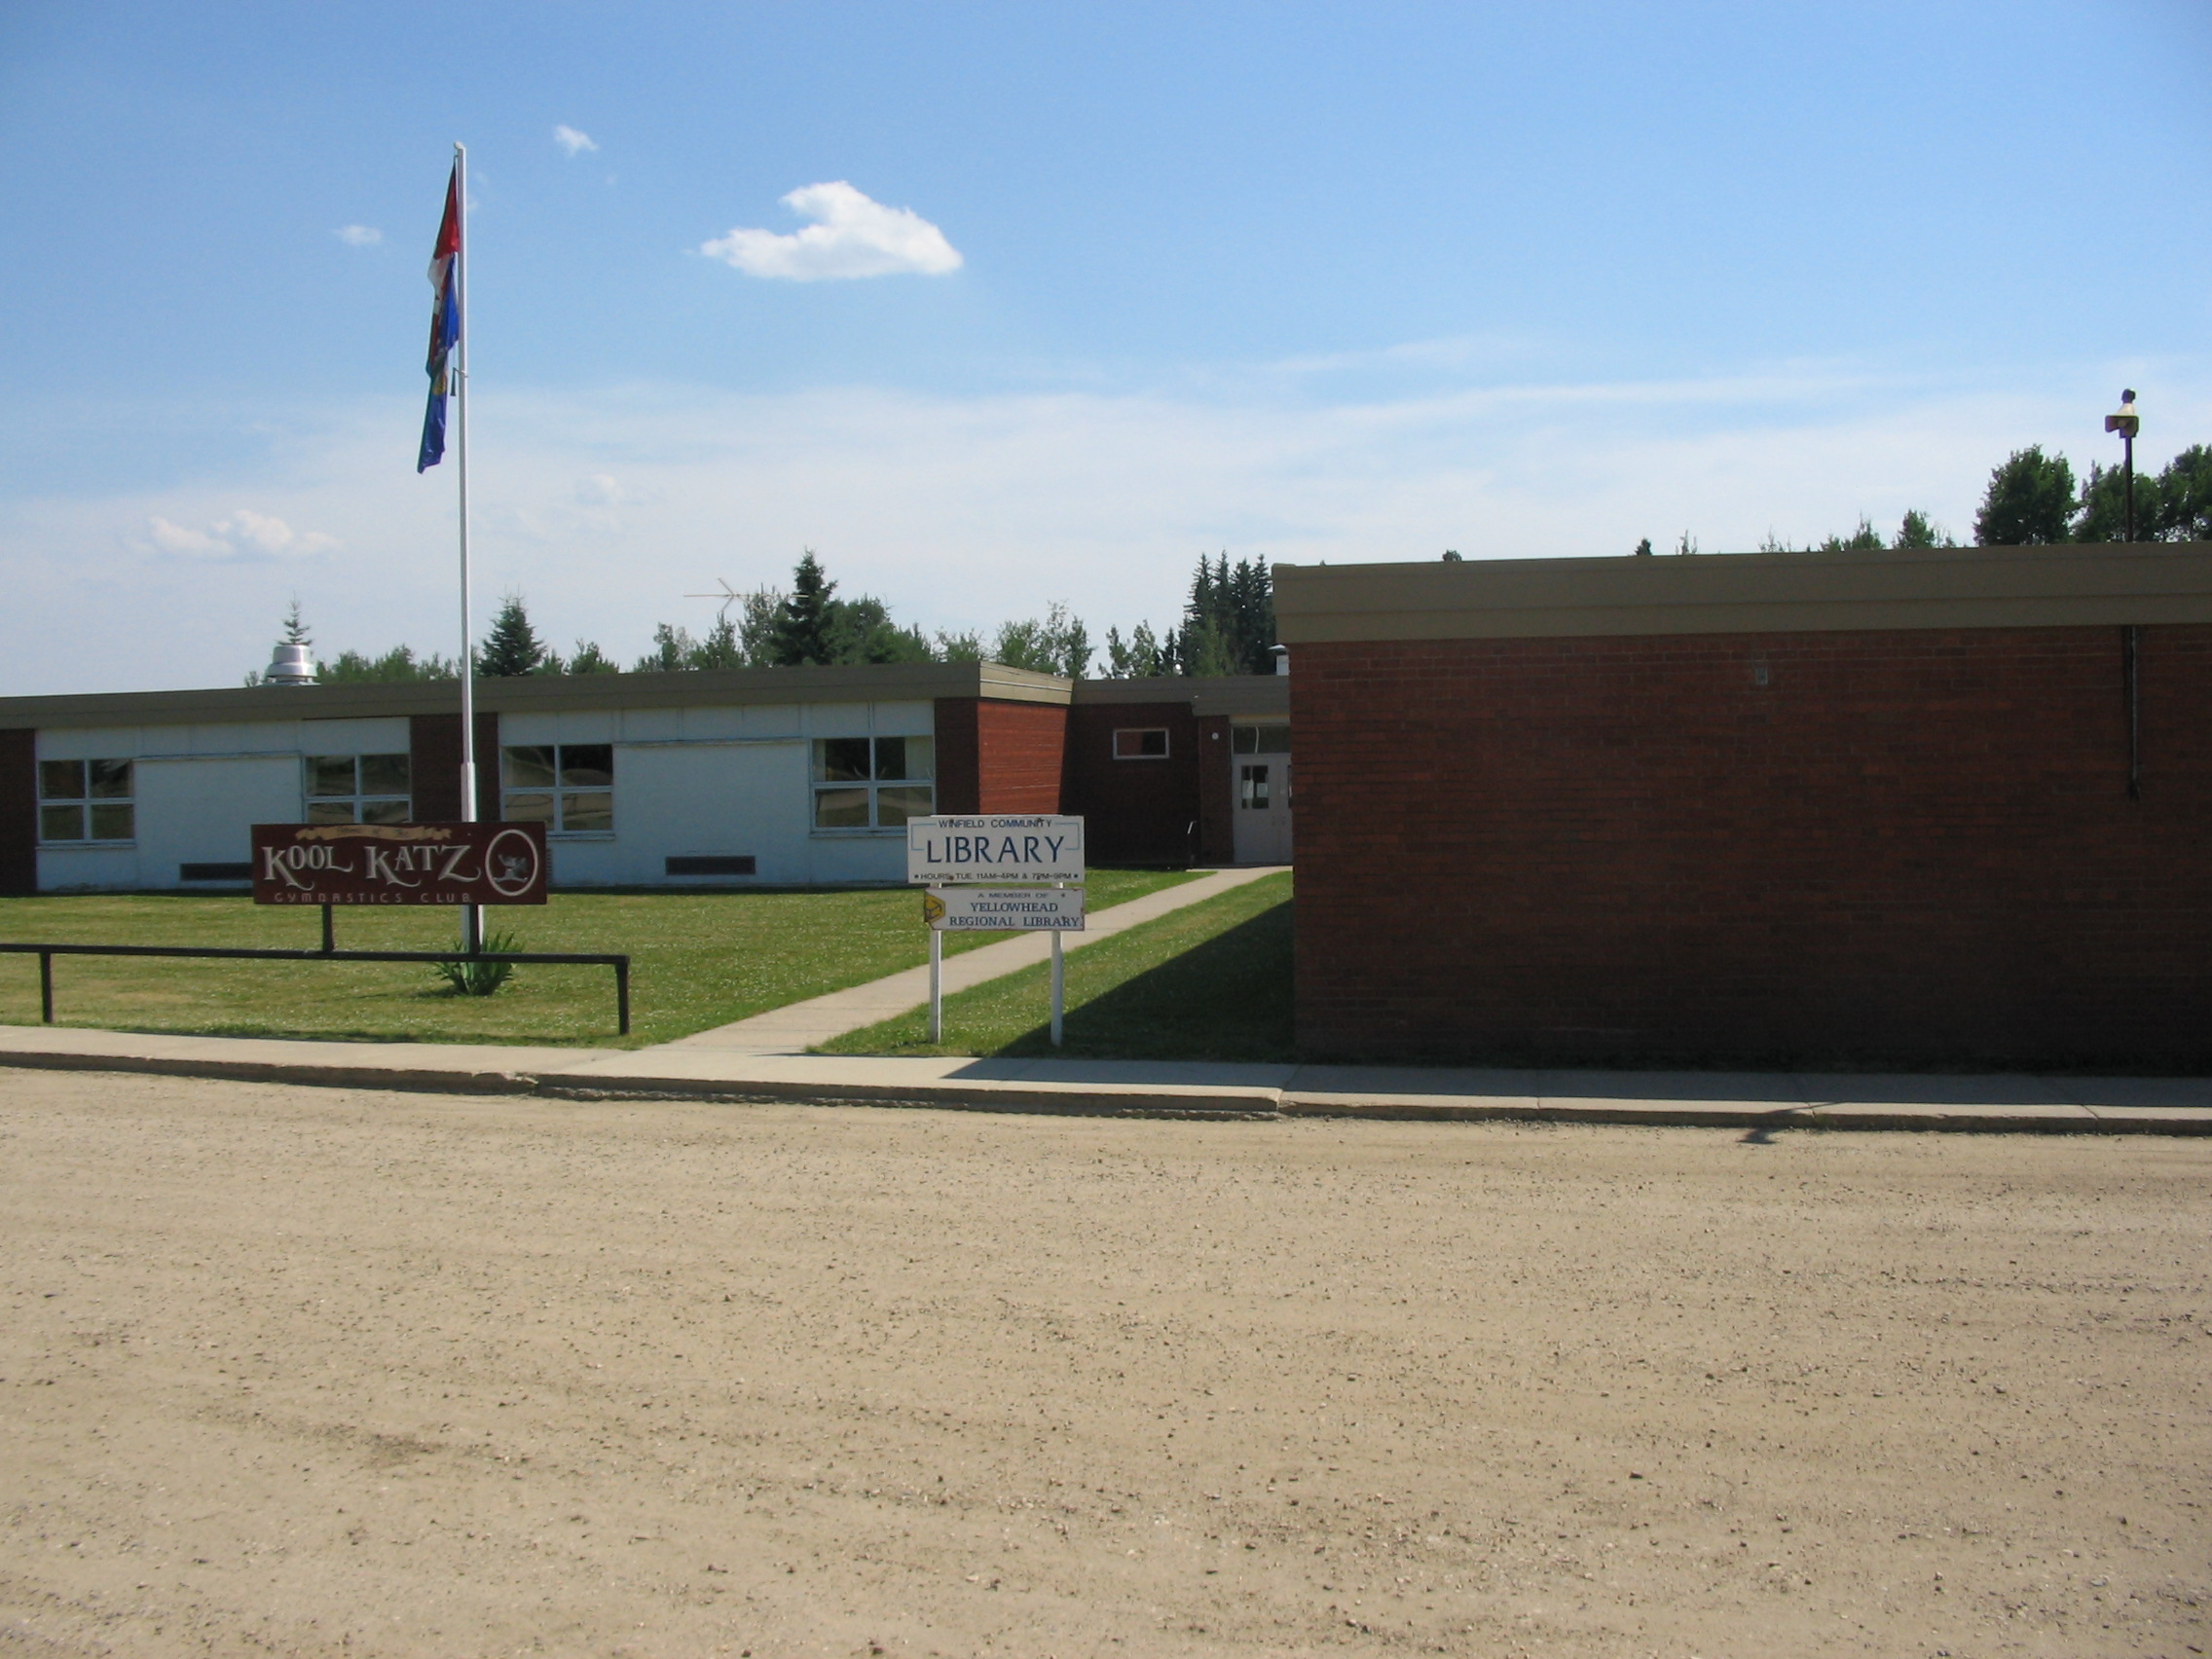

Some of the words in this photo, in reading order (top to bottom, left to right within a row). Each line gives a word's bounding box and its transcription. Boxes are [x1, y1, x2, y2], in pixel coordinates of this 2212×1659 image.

[939, 819, 984, 828] WINFIELD
[991, 819, 1051, 828] COMMUNITY
[927, 836, 1064, 864] LIBRARY
[261, 845, 353, 891] KOOL
[363, 844, 481, 888] KATZ
[274, 893, 401, 903] GYMNASTICS
[420, 893, 470, 903] CLUB
[970, 903, 1058, 911] YELLOWHEAD
[949, 916, 1014, 926] REGIONAL
[1023, 916, 1080, 926] LIBRARY
